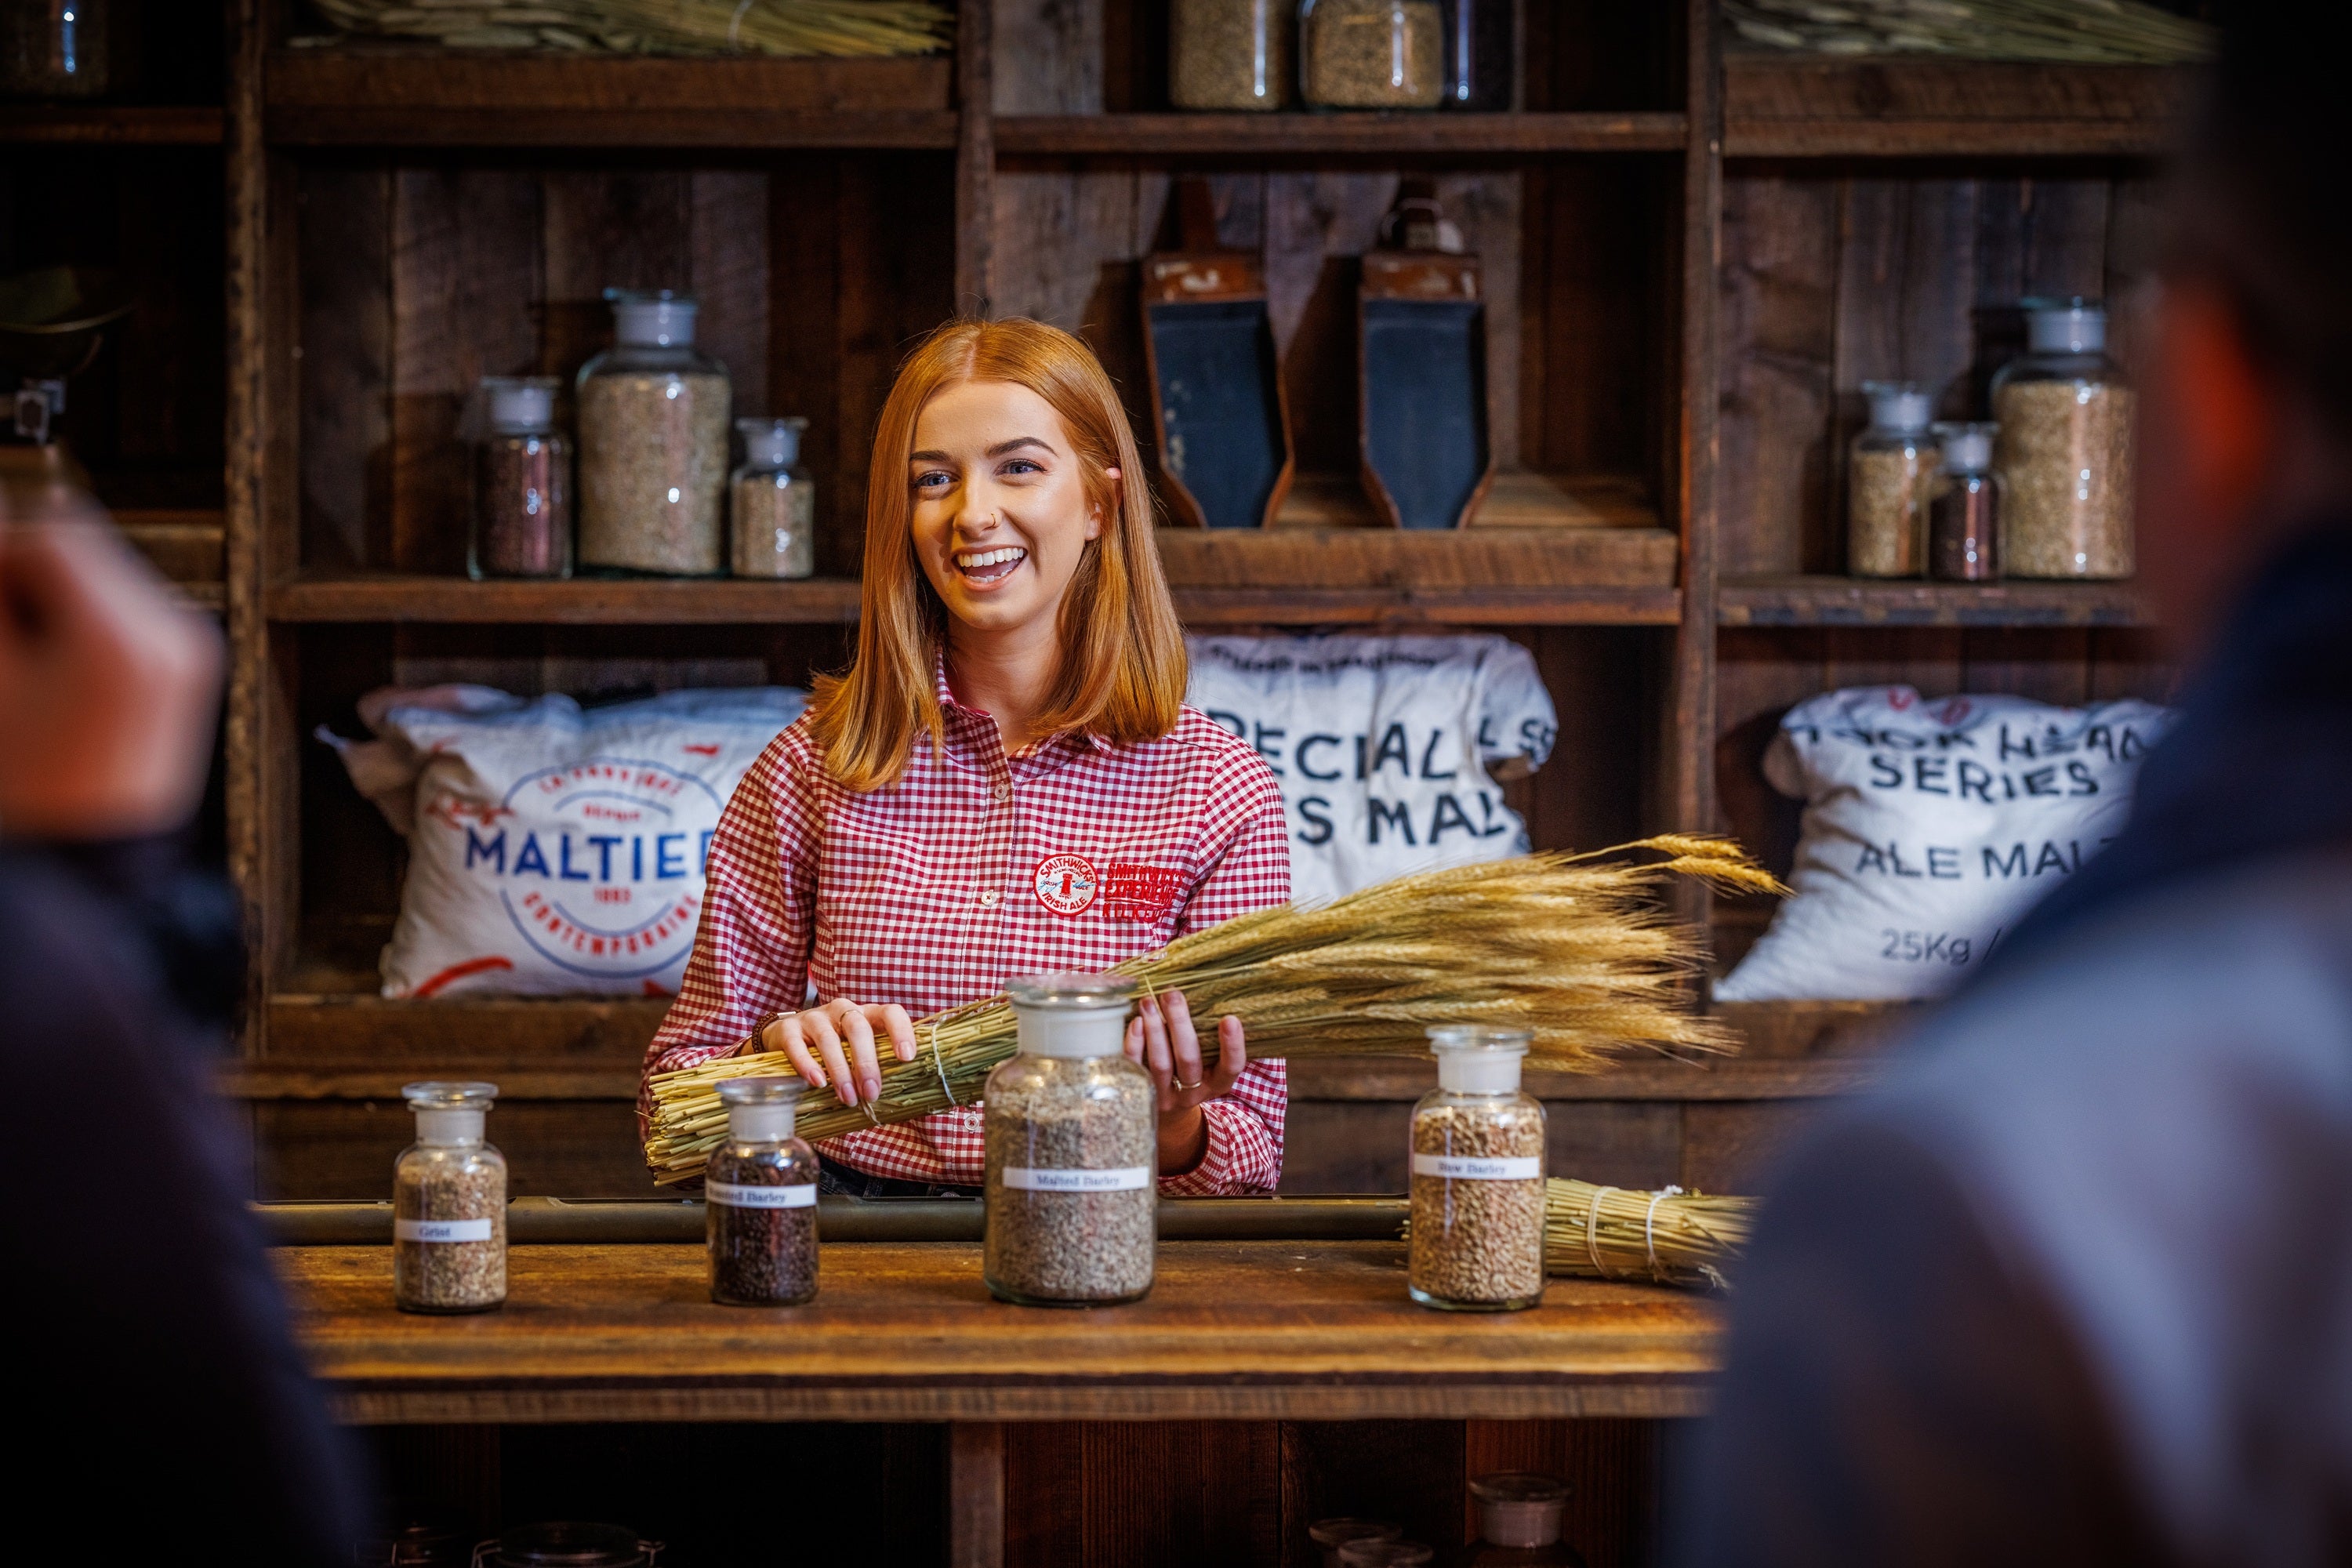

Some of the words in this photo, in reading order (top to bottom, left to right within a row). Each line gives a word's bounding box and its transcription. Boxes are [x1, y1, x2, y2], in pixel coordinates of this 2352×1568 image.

[1869, 754, 2100, 804] SERIES
[1854, 840, 1964, 880] ALE
[1042, 892, 1067, 910] IRISH
[1070, 896, 1087, 910] ALE
[1881, 927, 1972, 967] 25Kg
